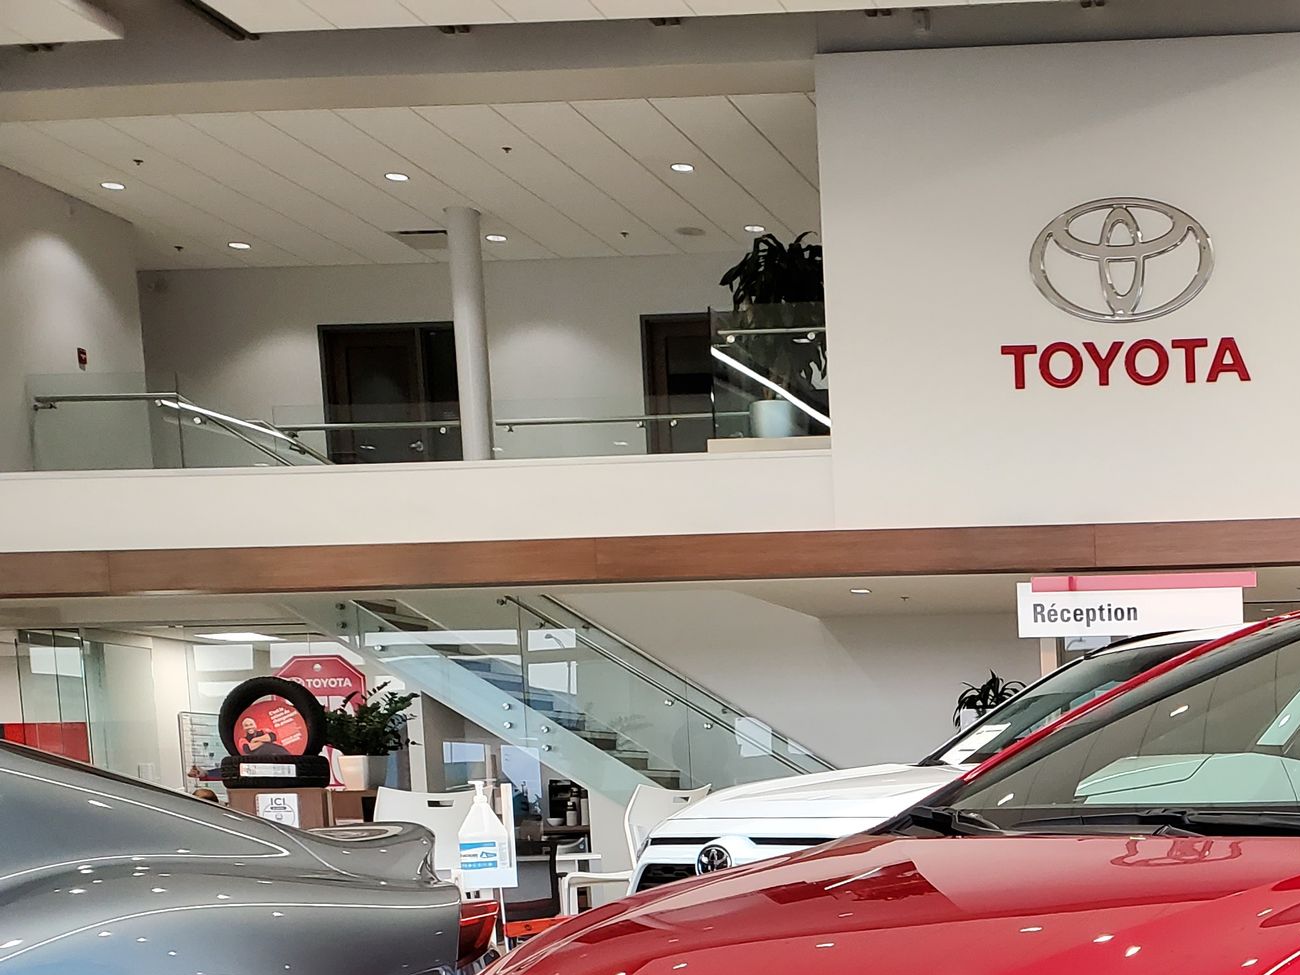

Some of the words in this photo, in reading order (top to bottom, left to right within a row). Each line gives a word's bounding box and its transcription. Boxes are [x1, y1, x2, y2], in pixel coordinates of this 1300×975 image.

[1001, 337, 1251, 389] TOYOTA
[1033, 603, 1138, 627] Réception
[306, 677, 352, 688] TOYOTA
[270, 797, 286, 806] ICI
